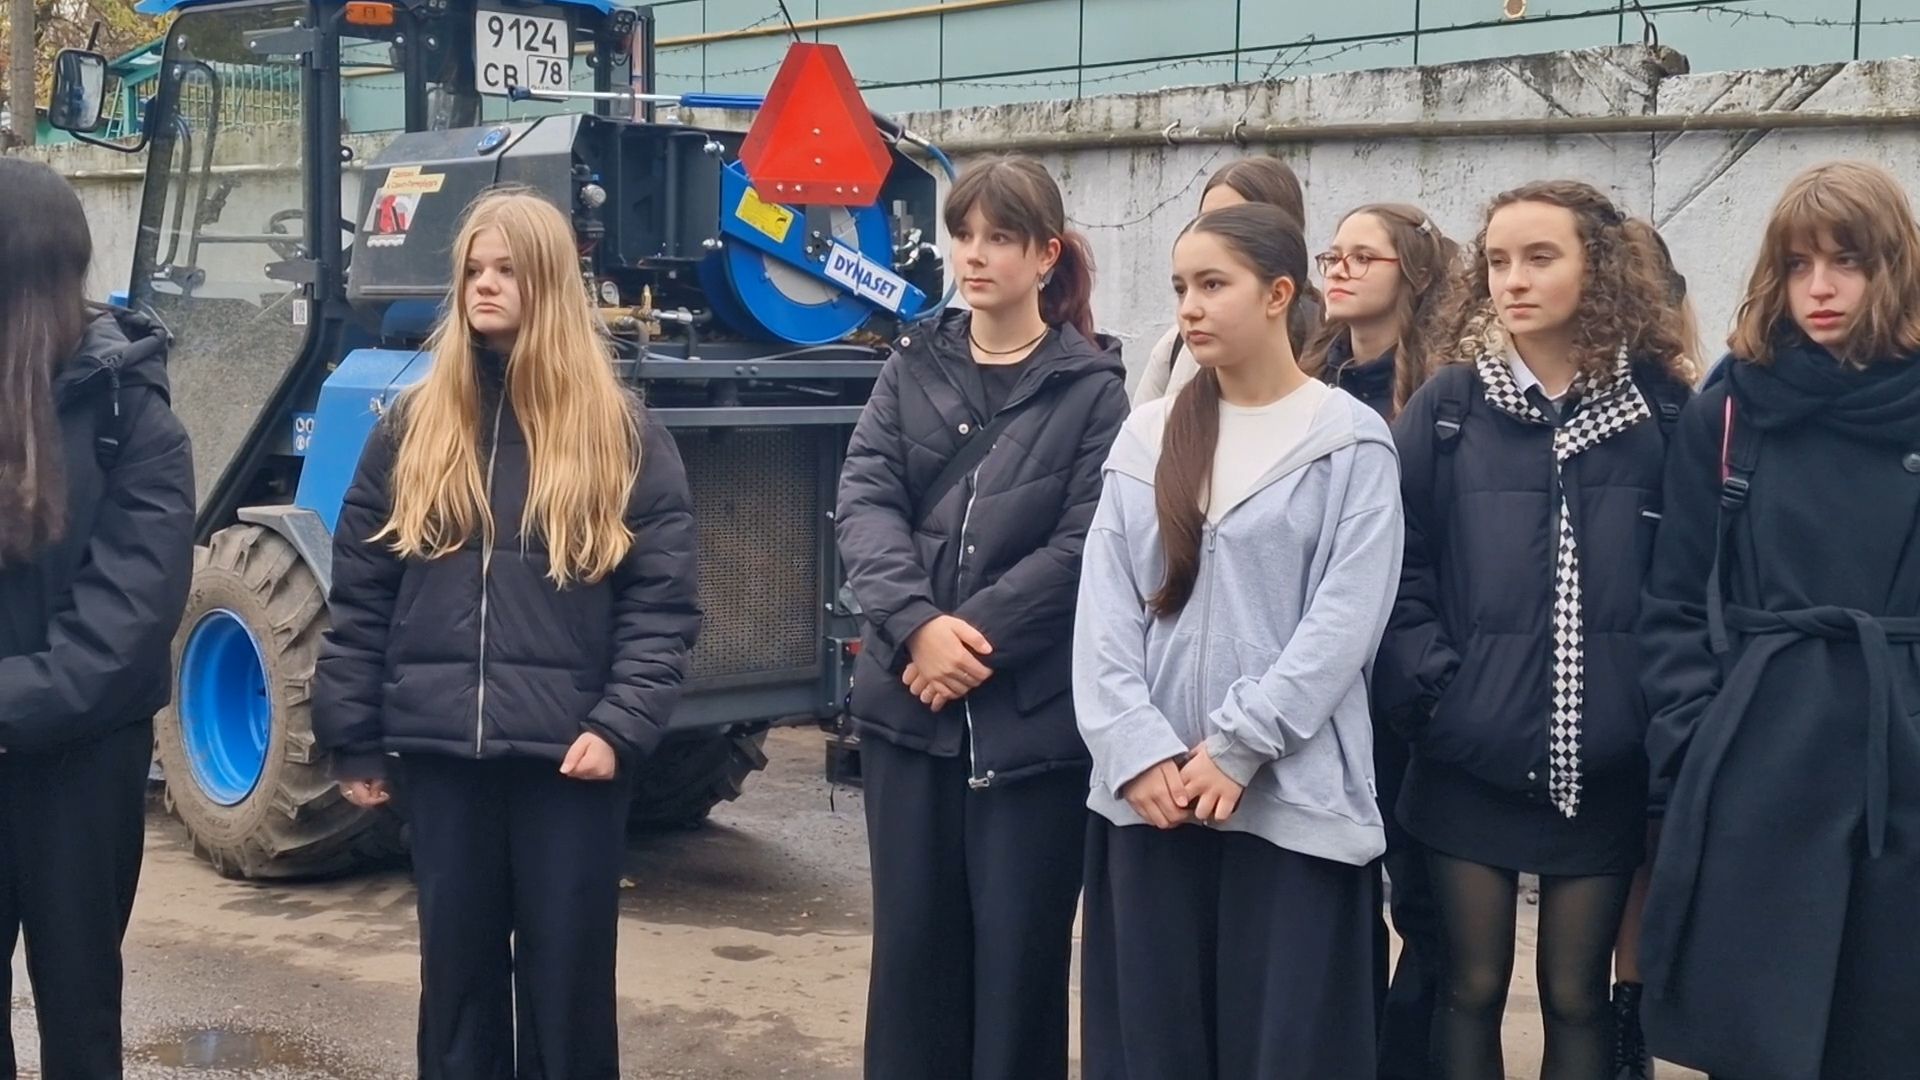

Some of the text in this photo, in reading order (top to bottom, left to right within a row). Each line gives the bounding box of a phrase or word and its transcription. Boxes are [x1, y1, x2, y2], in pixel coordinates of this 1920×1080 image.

[488, 15, 557, 54] 9124
[536, 59, 562, 85] 78
[834, 254, 898, 299] DYNASET
